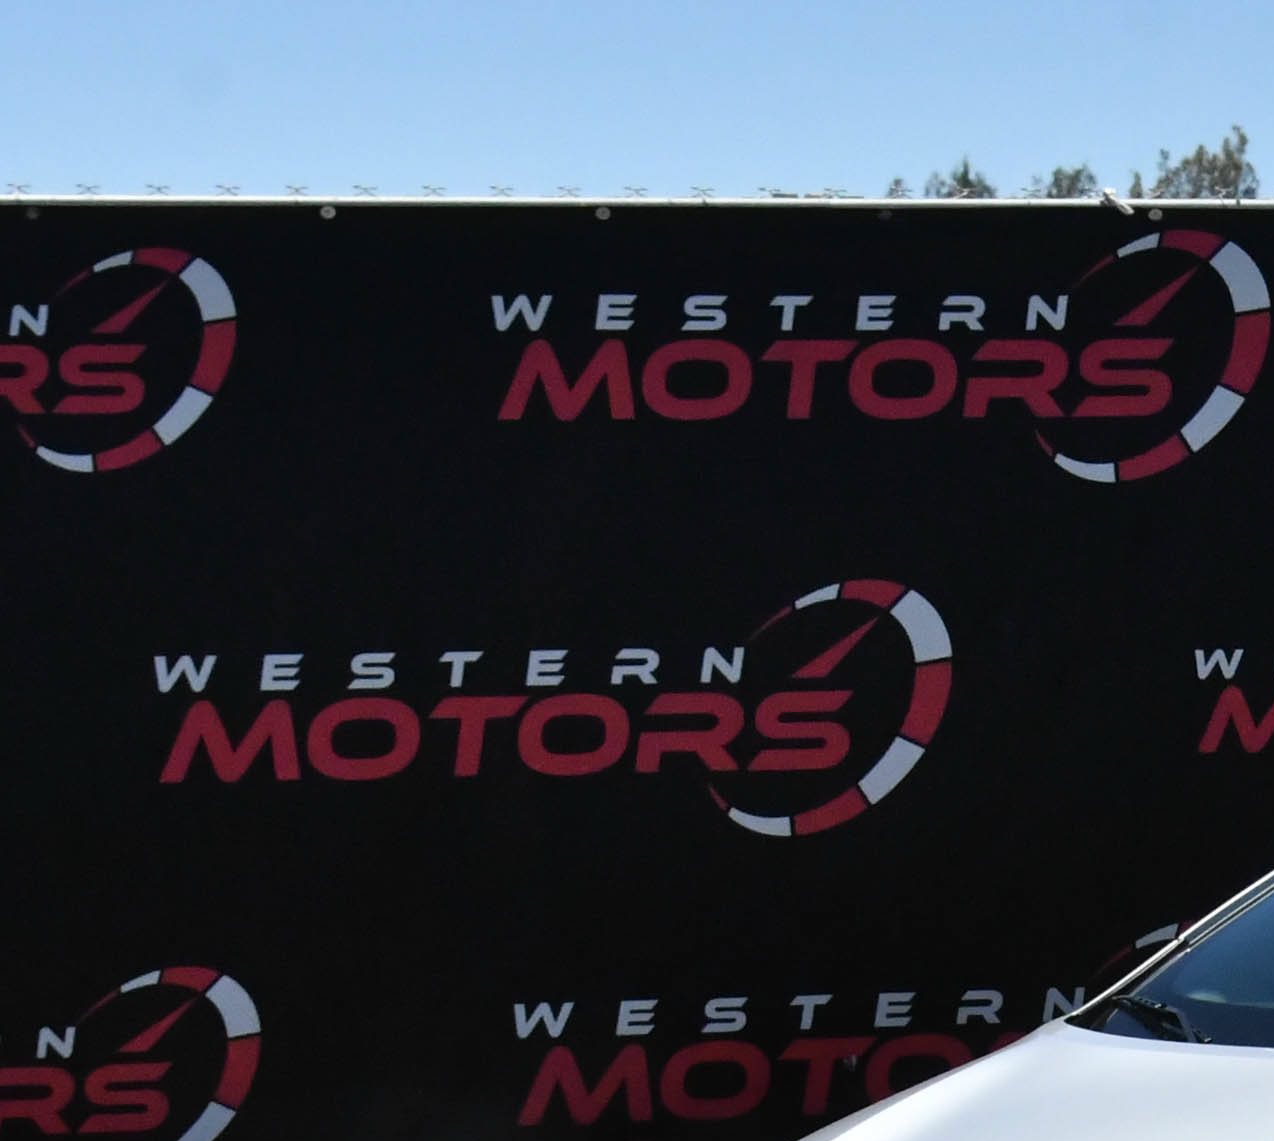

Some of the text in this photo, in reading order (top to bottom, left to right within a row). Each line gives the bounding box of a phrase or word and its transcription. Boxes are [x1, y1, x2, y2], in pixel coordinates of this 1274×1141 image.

[491, 294, 1068, 332] WESTERN
[499, 338, 1173, 421] MOTORS
[154, 646, 745, 693] WESTERN
[160, 690, 853, 784] MOTORS
[514, 986, 1085, 1039] WESTERN
[517, 1033, 1025, 1126] MOTO
